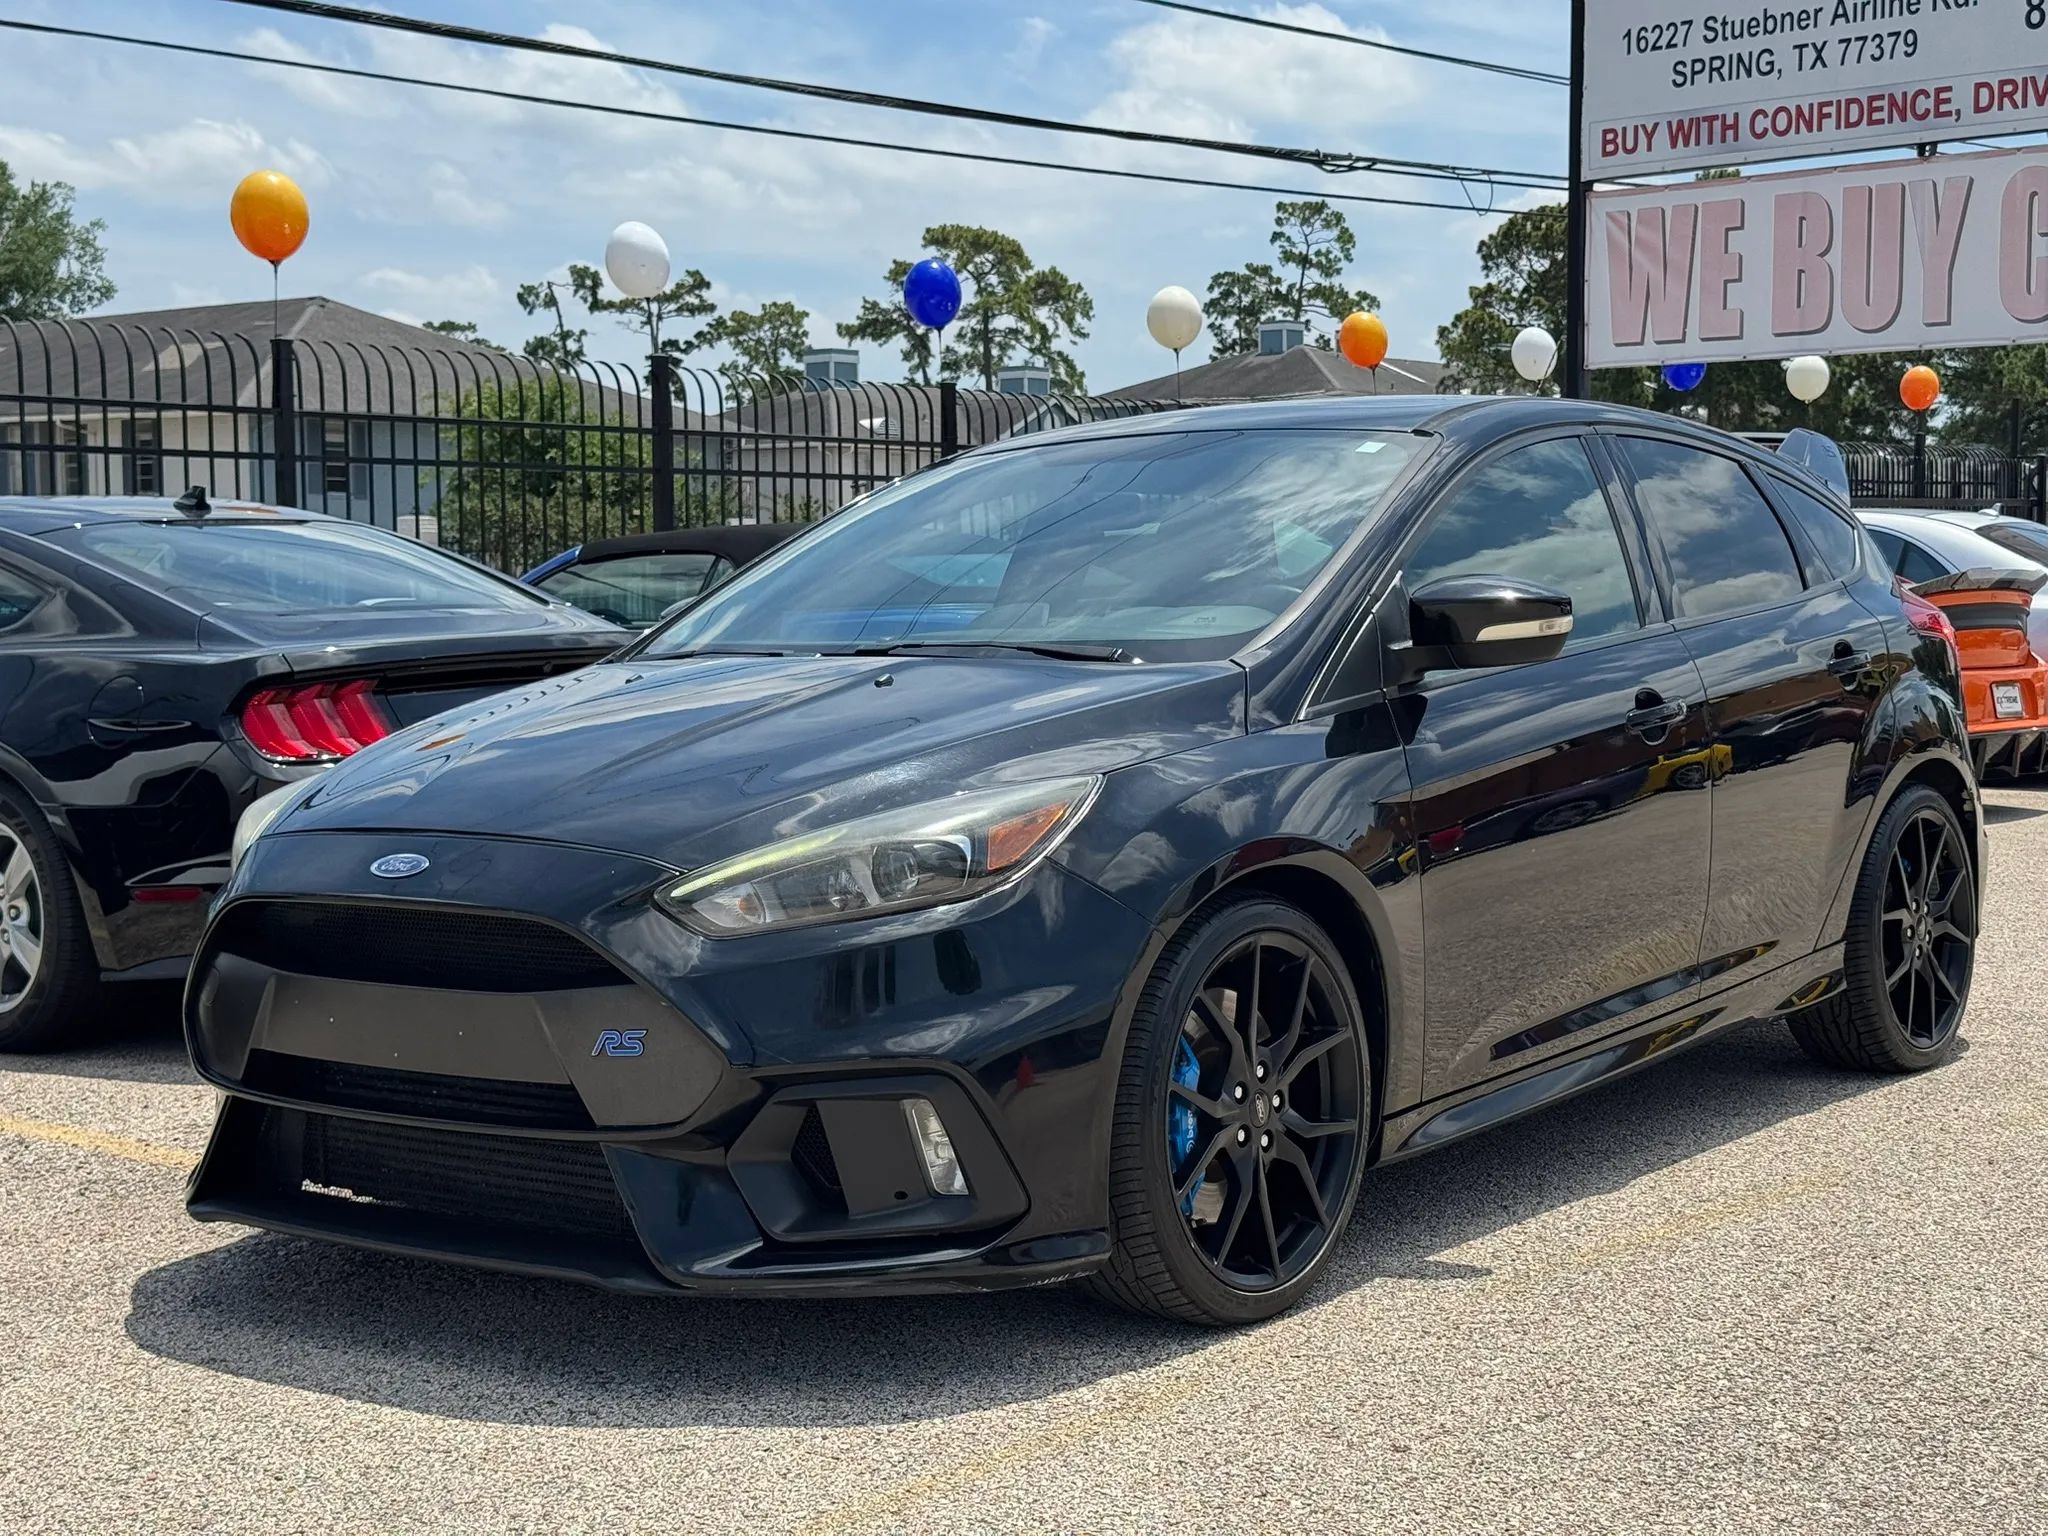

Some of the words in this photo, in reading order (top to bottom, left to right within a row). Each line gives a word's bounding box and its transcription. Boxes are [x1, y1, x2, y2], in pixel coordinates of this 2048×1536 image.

[1622, 19, 1694, 56] 16227
[1702, 7, 1823, 44] Stuebner
[1830, 0, 1921, 26] Airline
[1672, 48, 1782, 88] SPRING,
[1792, 40, 1828, 72] TX
[1838, 29, 1918, 65] 77379
[1601, 122, 1660, 158] BUY
[1666, 112, 1739, 149] WITH
[1749, 86, 1961, 140] CONFIDENCE,
[1973, 75, 2048, 114] DRIV
[1605, 199, 1745, 347] WE
[1772, 176, 1974, 337] BUY
[591, 1030, 647, 1057] RS
